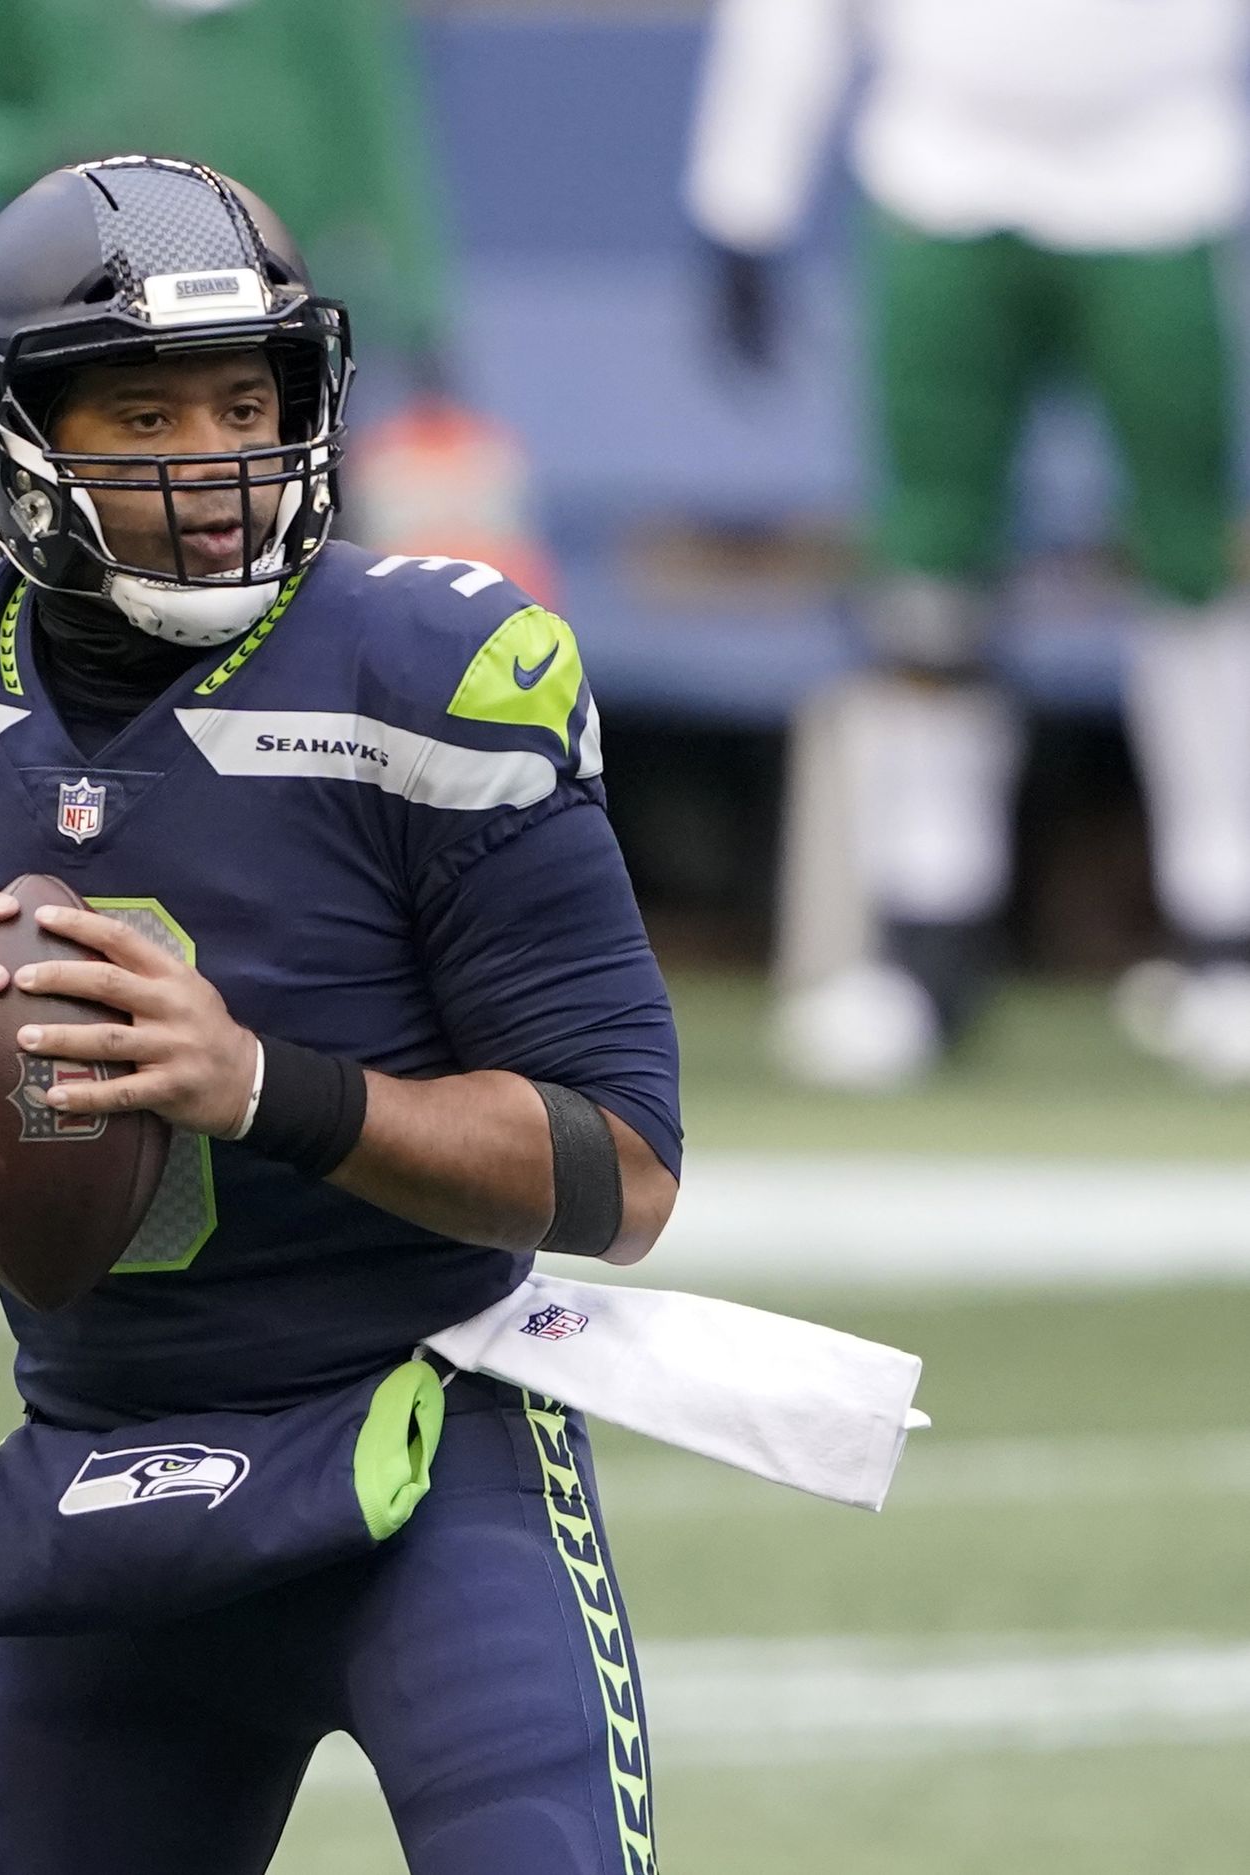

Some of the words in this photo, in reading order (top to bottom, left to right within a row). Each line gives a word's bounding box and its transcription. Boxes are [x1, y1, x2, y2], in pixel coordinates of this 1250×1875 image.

[176, 277, 239, 297] SEAHAWKS
[64, 807, 95, 831] NFL
[540, 1314, 584, 1340] NFL
